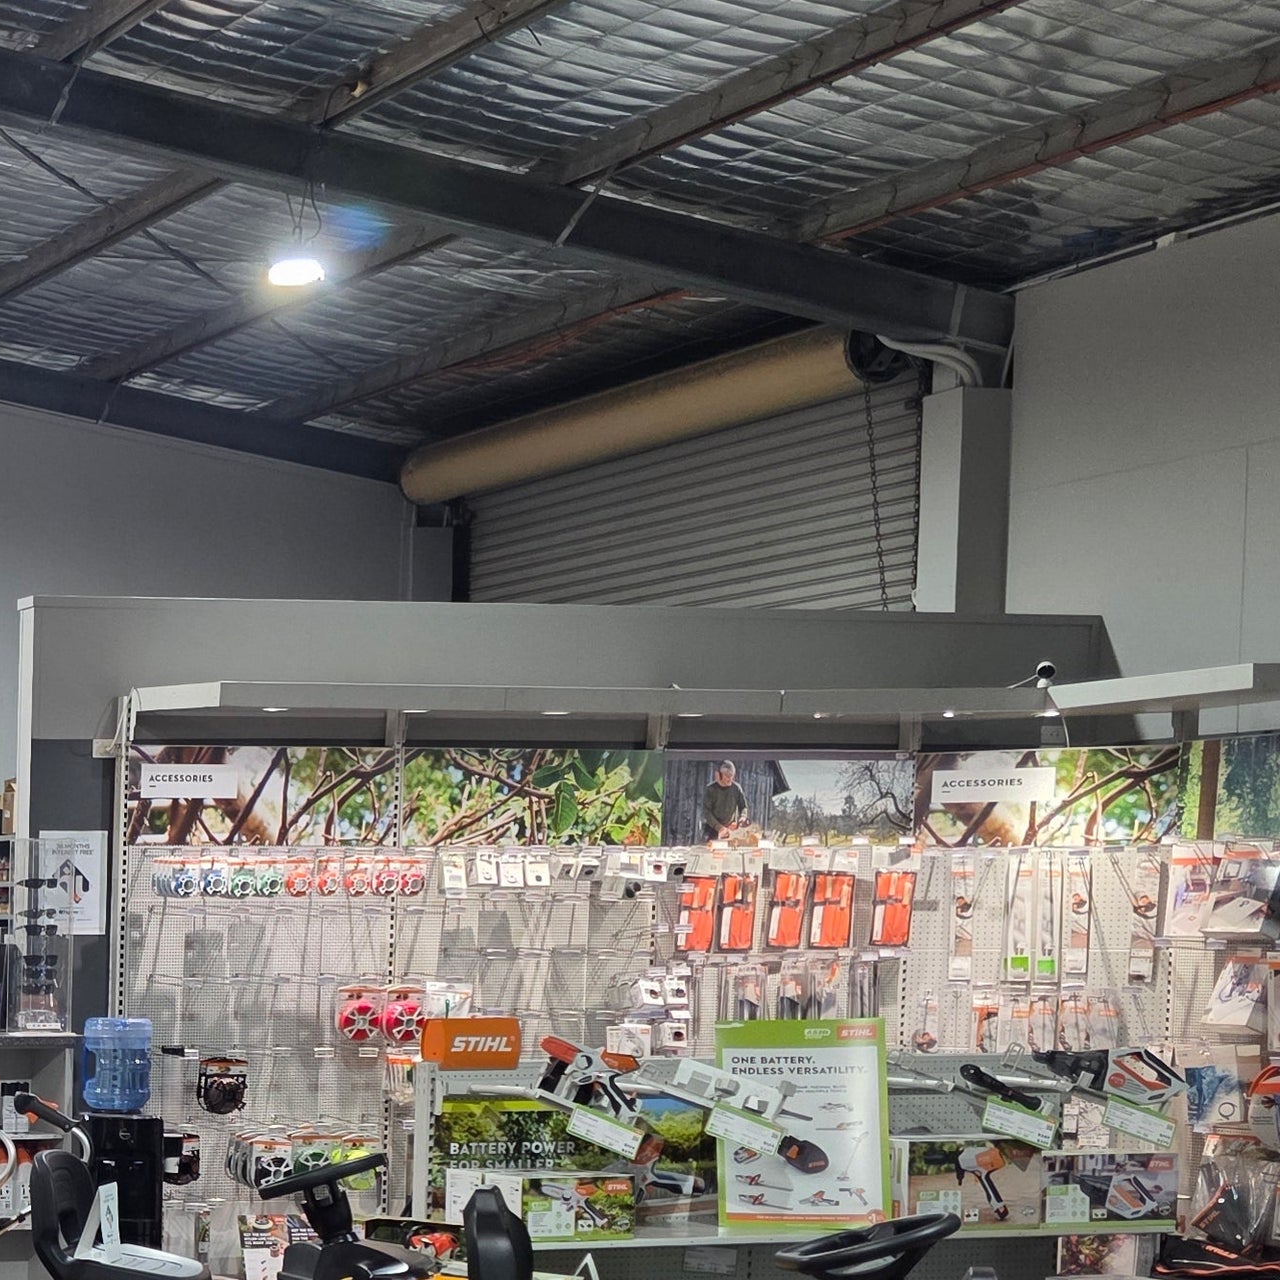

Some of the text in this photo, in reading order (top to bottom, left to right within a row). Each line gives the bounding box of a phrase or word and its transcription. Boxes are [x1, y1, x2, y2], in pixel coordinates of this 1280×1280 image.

[148, 773, 214, 784] ACCESSORIES
[942, 776, 1023, 790] ACCESSORIES
[840, 1029, 873, 1037] STIHL
[450, 1036, 512, 1052] STIHL
[731, 1056, 815, 1065] ONE BATTERY.
[732, 1065, 868, 1075] ENDLESS VERSATILITY.
[449, 1141, 576, 1155] BATTERY POWER
